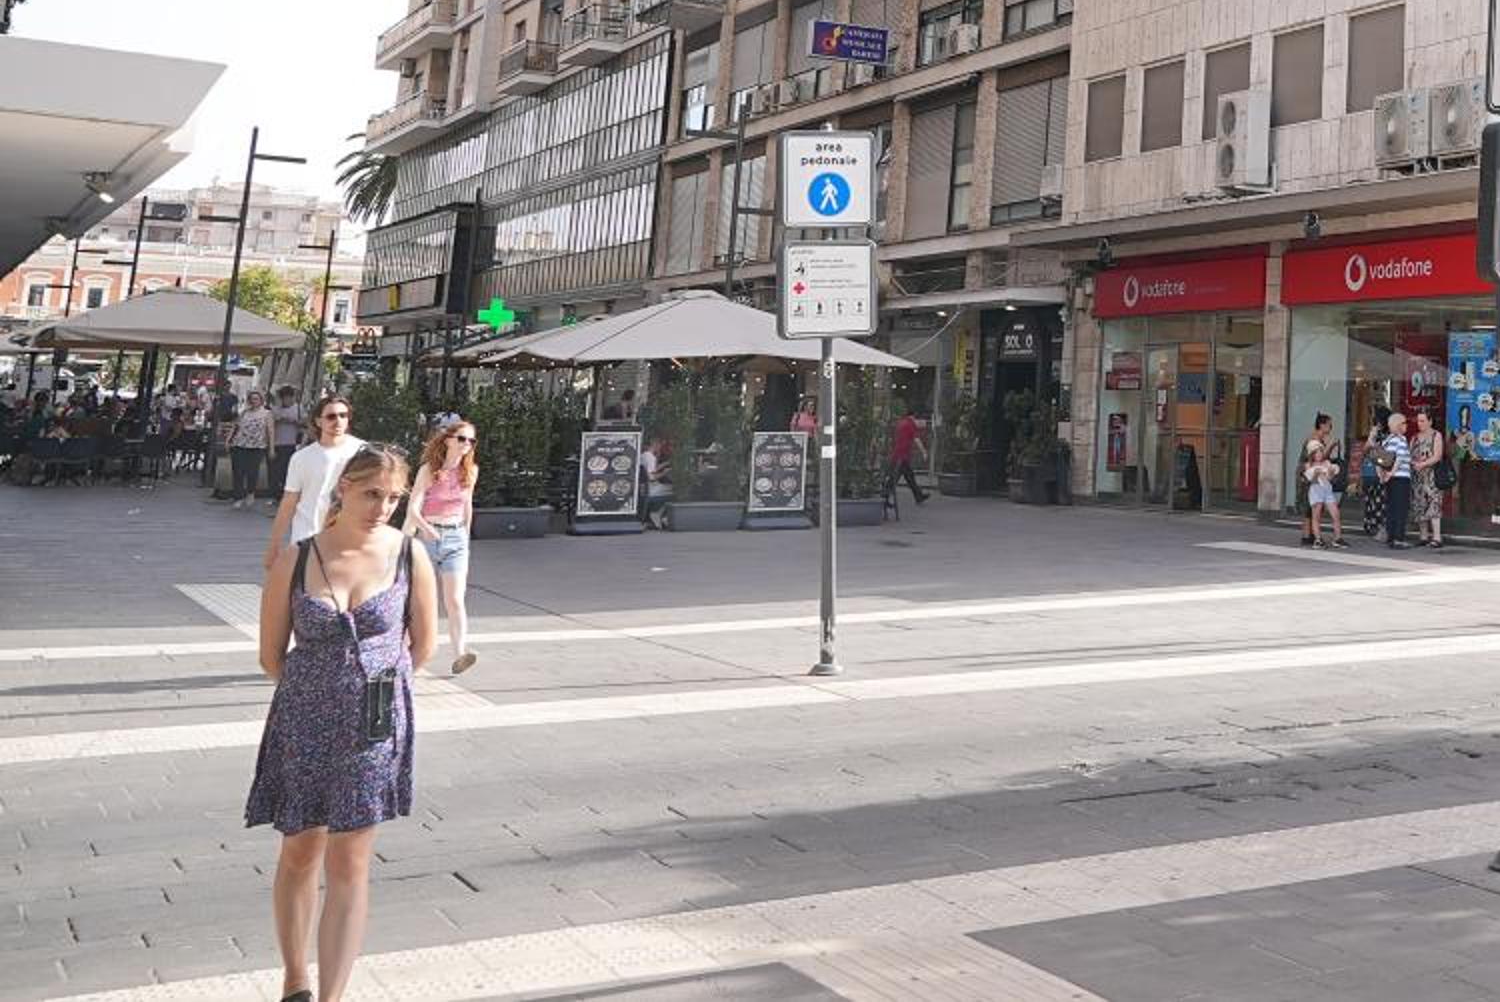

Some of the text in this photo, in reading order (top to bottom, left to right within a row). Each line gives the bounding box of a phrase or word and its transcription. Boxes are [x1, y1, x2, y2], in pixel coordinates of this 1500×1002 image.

[815, 143, 842, 152] area
[800, 155, 857, 167] pedonale
[1369, 257, 1433, 279] vodafone
